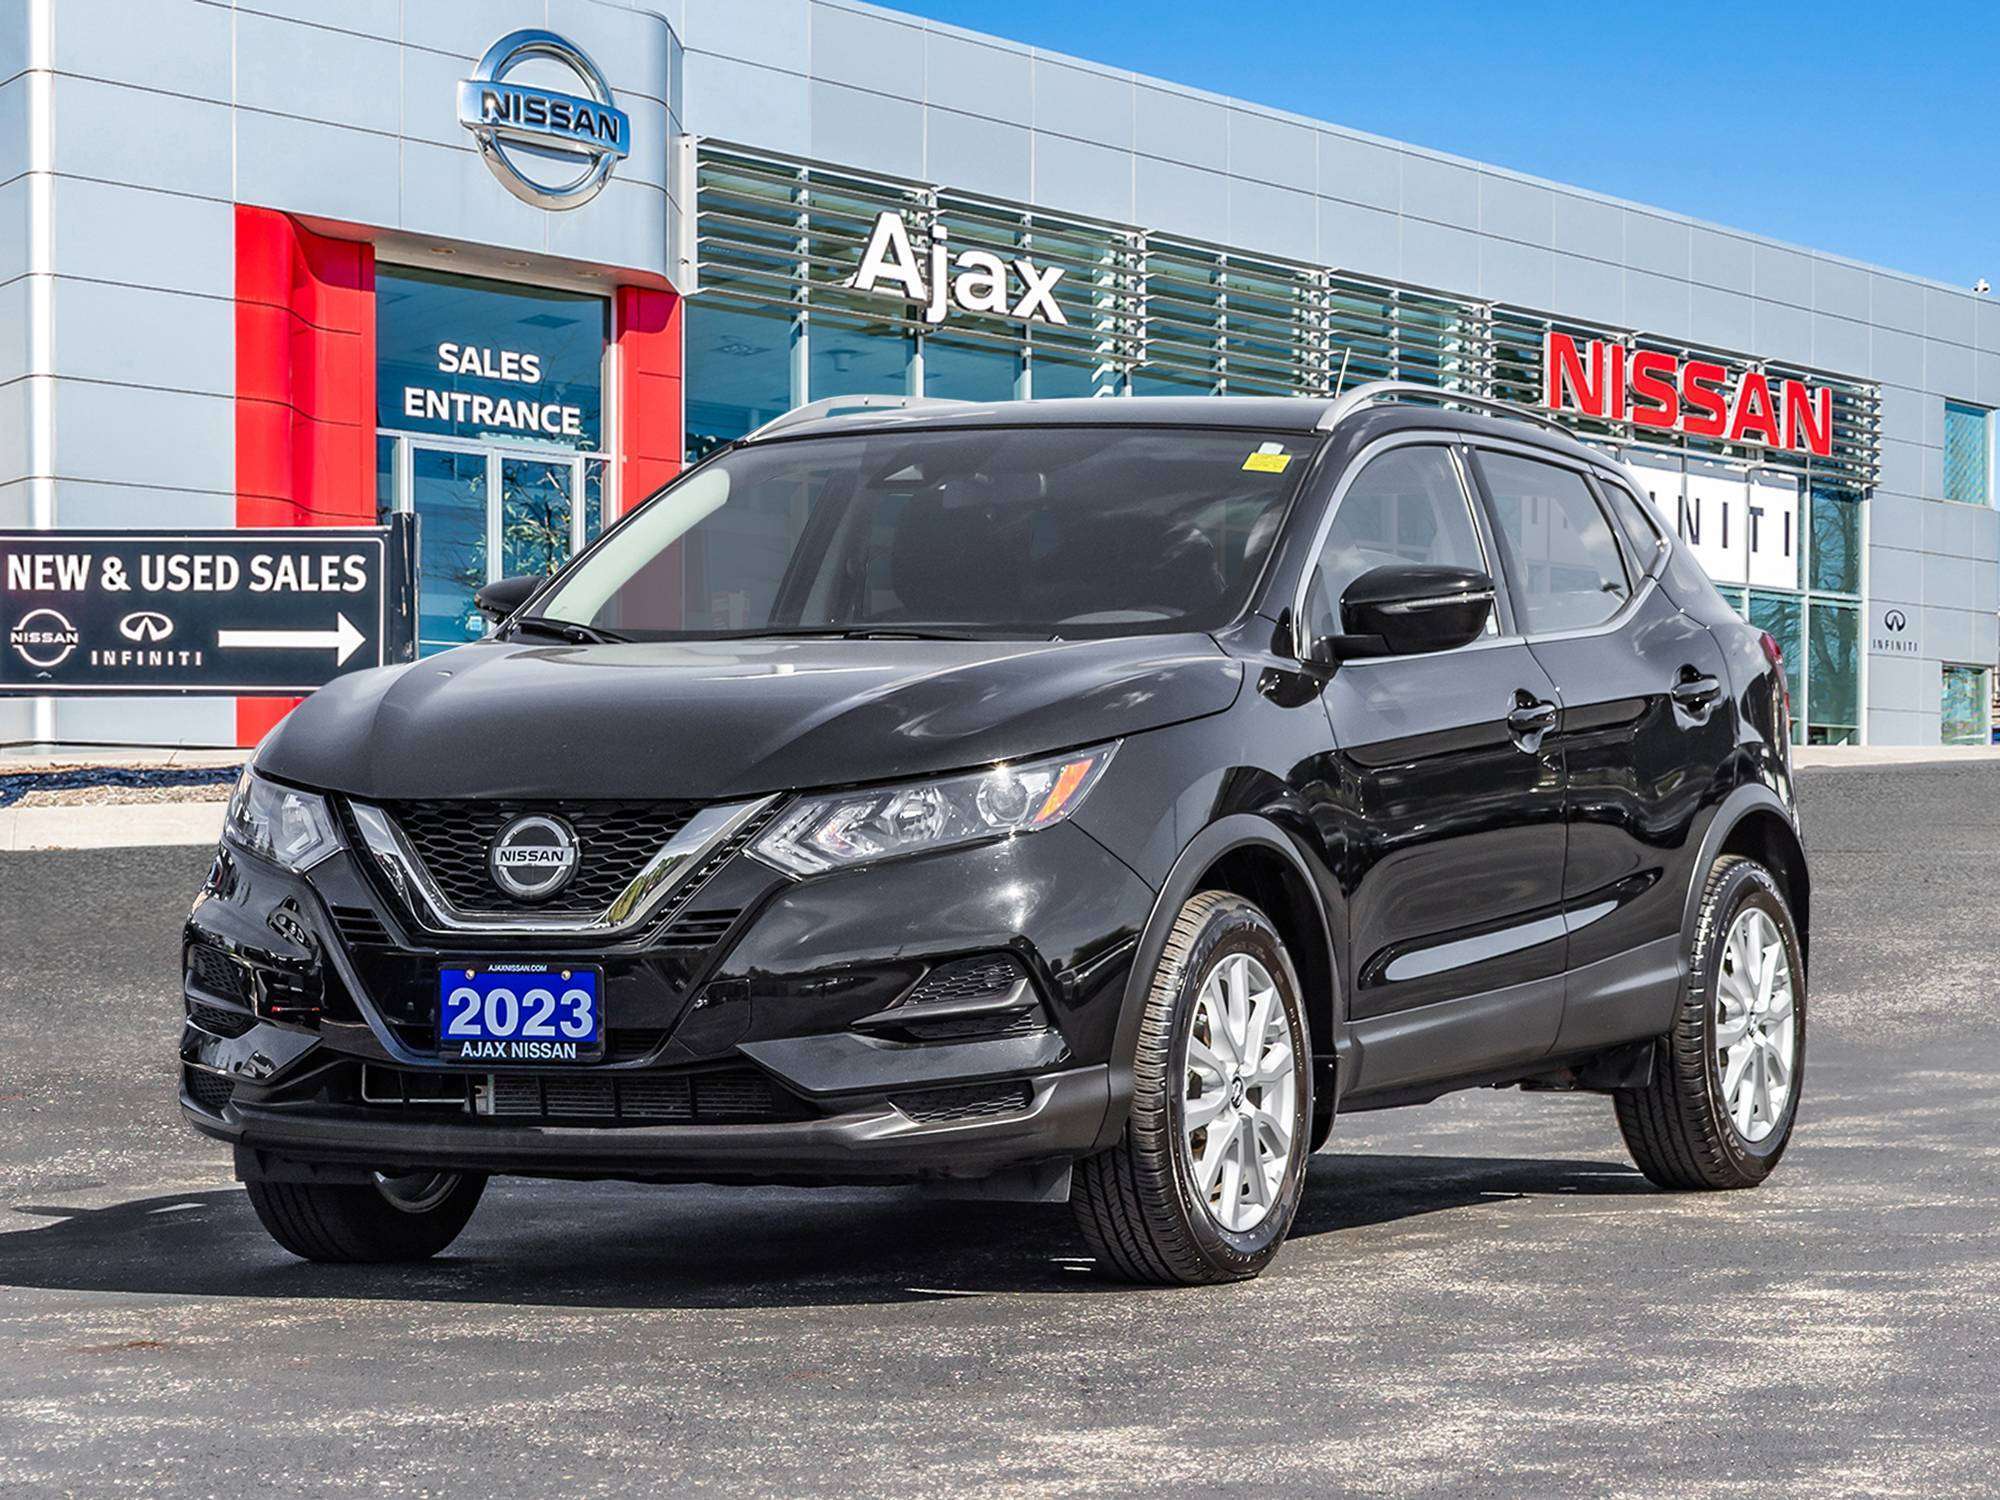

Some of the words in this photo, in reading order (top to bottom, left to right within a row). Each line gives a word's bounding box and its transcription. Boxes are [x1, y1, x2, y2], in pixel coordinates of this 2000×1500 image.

[482, 89, 619, 144] NISSAN
[851, 211, 1068, 323] Ajax
[437, 342, 541, 383] SALES
[404, 387, 580, 435] ENTRANCE
[1543, 331, 1833, 457] NISSAN
[1650, 491, 1790, 557] NITI
[7, 554, 92, 591] NEW
[101, 555, 131, 591] &
[141, 554, 241, 592] USED
[249, 554, 367, 593] SALES
[10, 631, 79, 644] NISSAN
[1872, 639, 1918, 651] INFINITI
[91, 651, 202, 666] INFINITI
[500, 850, 564, 862] NISSAN
[487, 964, 548, 972] AJAXNISSAN.COM
[448, 987, 593, 1038] 2023
[460, 1041, 507, 1058] AJAX
[511, 1042, 576, 1059] NISSAN
